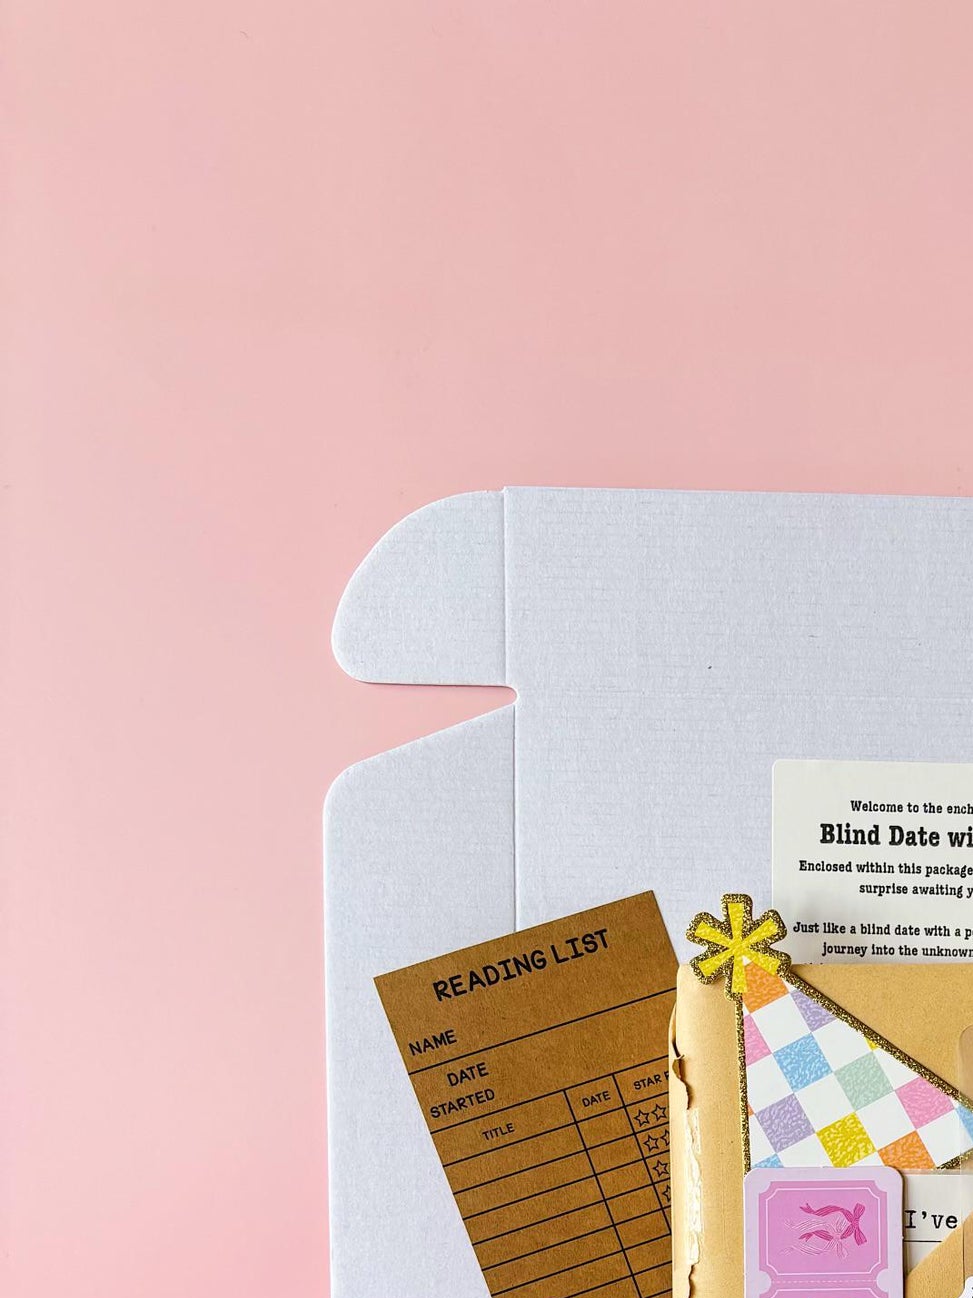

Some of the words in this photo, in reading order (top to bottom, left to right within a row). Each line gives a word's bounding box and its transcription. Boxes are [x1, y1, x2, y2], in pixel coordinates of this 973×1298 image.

[850, 800, 904, 813] Welcome
[906, 802, 920, 813] to
[922, 802, 943, 814] the
[819, 822, 881, 846] Blind
[888, 825, 940, 847] Date
[798, 859, 853, 873] Enclosed
[855, 861, 895, 874] within
[897, 862, 922, 875] this
[925, 863, 973, 879] package
[859, 882, 909, 897] surprise
[911, 883, 964, 899] awaiting
[792, 921, 820, 934] Just
[822, 921, 847, 935] like
[849, 925, 857, 935] a
[860, 923, 891, 936] blind
[894, 924, 921, 936] date
[923, 924, 951, 937] with
[954, 928, 962, 937] a
[821, 941, 868, 958] journey
[871, 943, 895, 956] into
[897, 944, 919, 957] the
[432, 949, 547, 1002] READING
[550, 928, 608, 965] LIST
[408, 1029, 458, 1056] NAME
[446, 1062, 490, 1088] DATE
[633, 1074, 663, 1090] STAR
[429, 1088, 496, 1119] STARTED
[581, 1091, 612, 1109] DATE
[481, 1122, 516, 1141] TITLE
